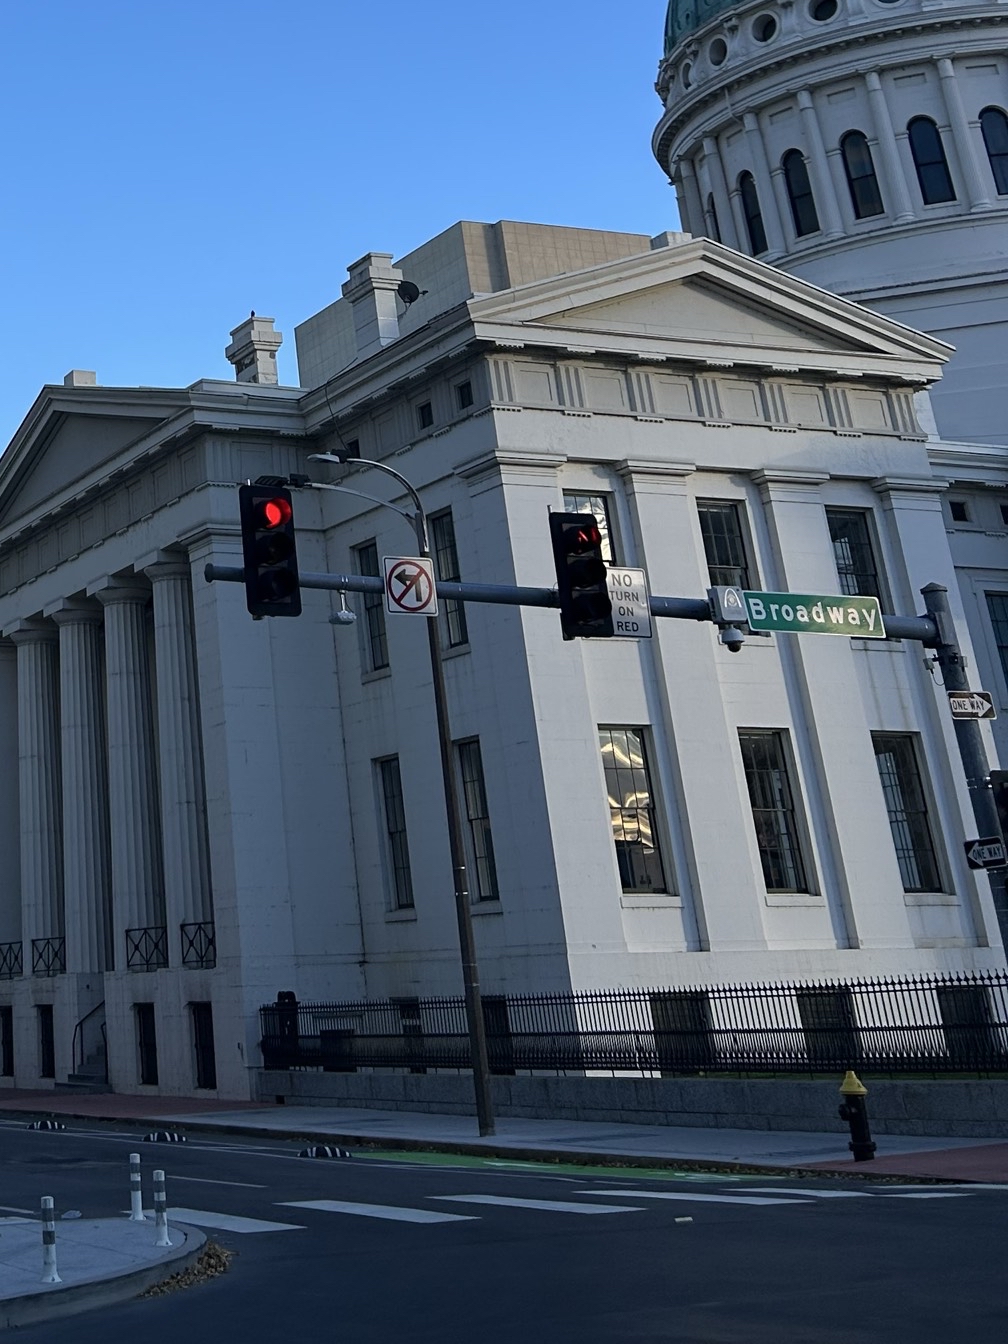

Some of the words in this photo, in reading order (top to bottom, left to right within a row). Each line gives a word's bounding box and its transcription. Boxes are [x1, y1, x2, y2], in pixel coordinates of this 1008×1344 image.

[611, 573, 633, 587] NO
[608, 590, 640, 602] TURN
[618, 606, 634, 617] ON
[748, 597, 876, 632] Broadway
[616, 620, 639, 632] RED
[952, 699, 968, 711] ONE
[969, 699, 985, 711] WAY
[972, 849, 987, 861] ONE
[987, 845, 1002, 858] WAY
